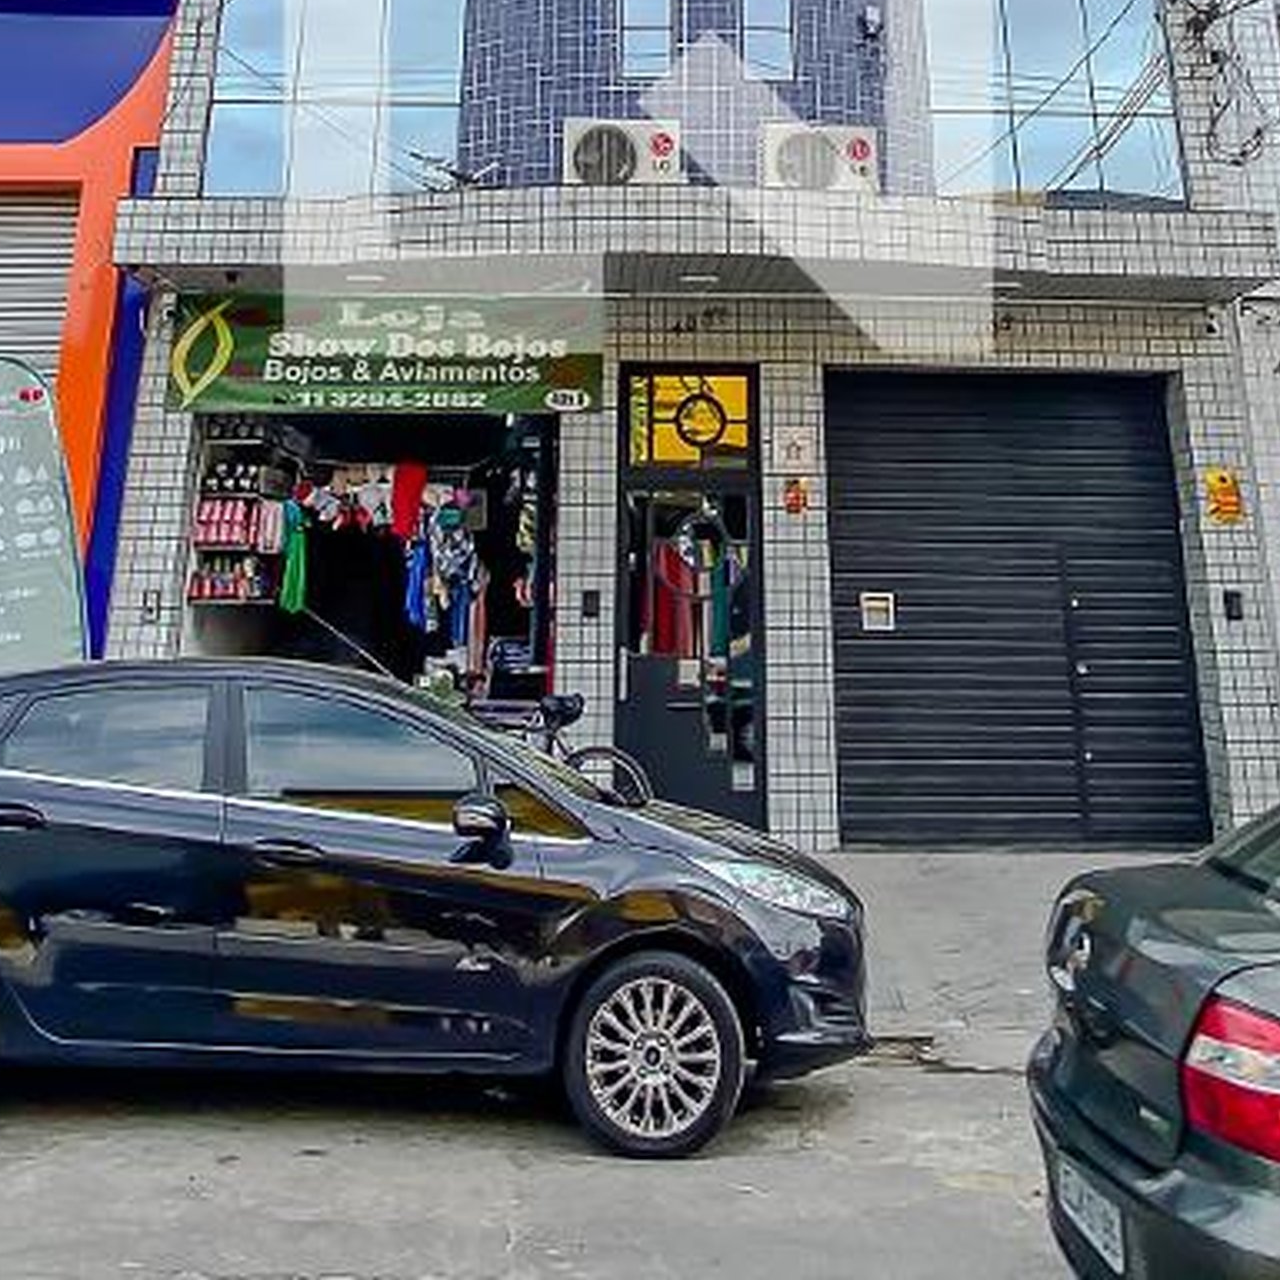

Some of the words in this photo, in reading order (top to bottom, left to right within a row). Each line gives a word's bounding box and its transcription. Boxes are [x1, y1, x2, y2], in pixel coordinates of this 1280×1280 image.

[339, 302, 486, 332] Loja
[269, 333, 377, 357] Show
[386, 333, 456, 357] Dos
[466, 333, 568, 362] Bojos
[264, 359, 343, 384] Bojos
[352, 359, 370, 381] &
[379, 359, 540, 382] Aviamentos
